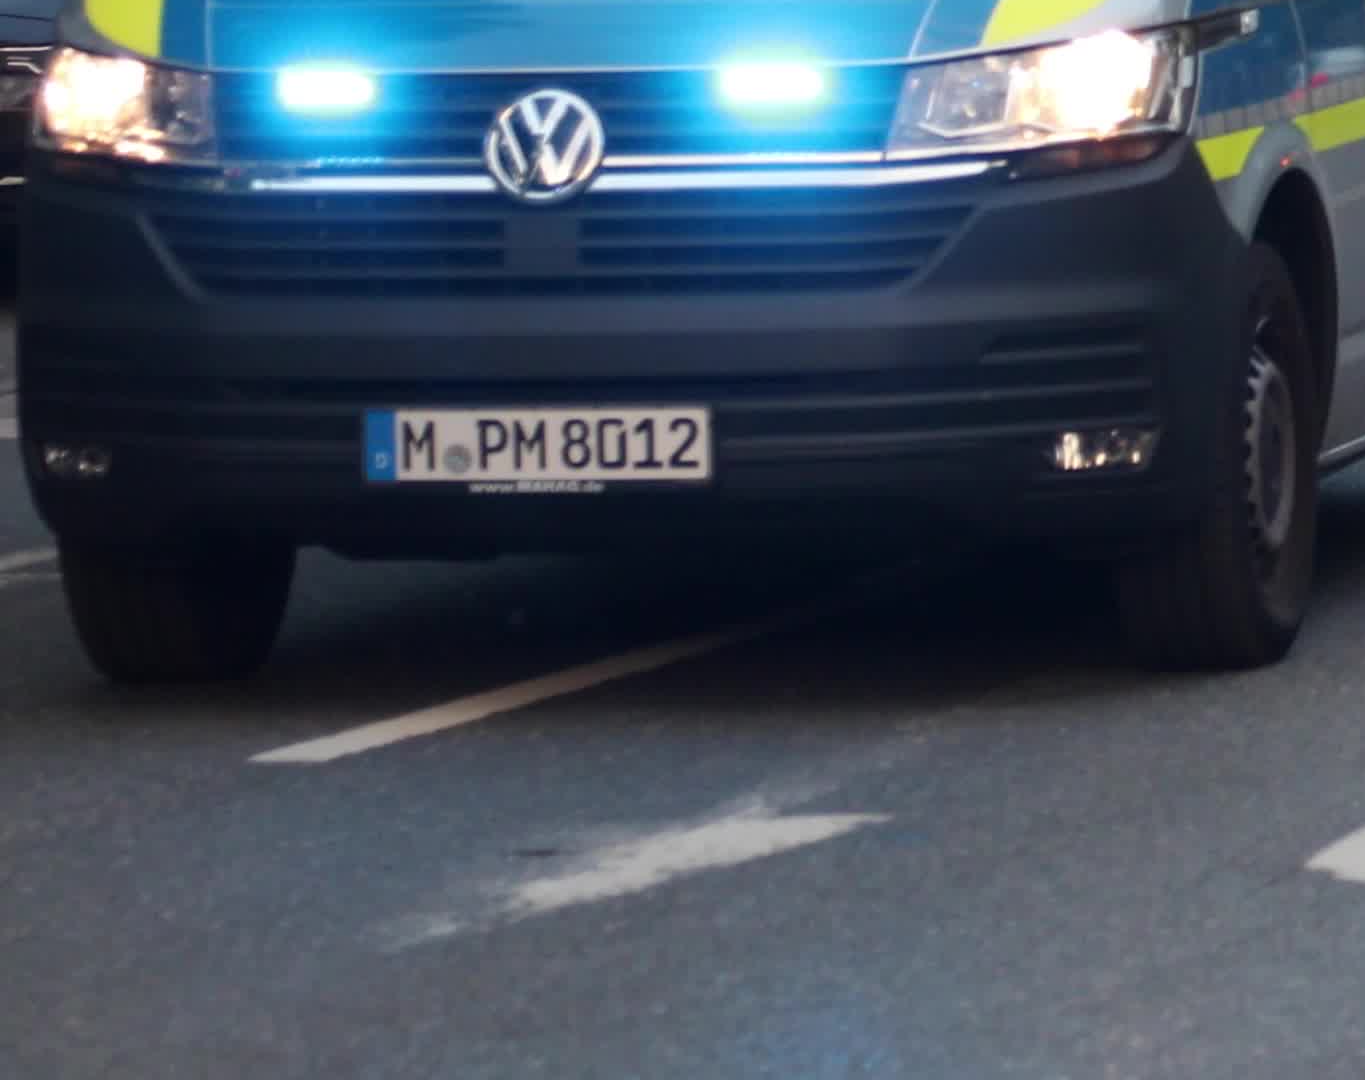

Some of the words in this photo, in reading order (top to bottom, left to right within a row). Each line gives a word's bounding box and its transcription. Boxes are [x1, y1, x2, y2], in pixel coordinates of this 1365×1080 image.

[402, 420, 436, 469] M
[477, 419, 547, 469] PM
[561, 418, 700, 469] 8012
